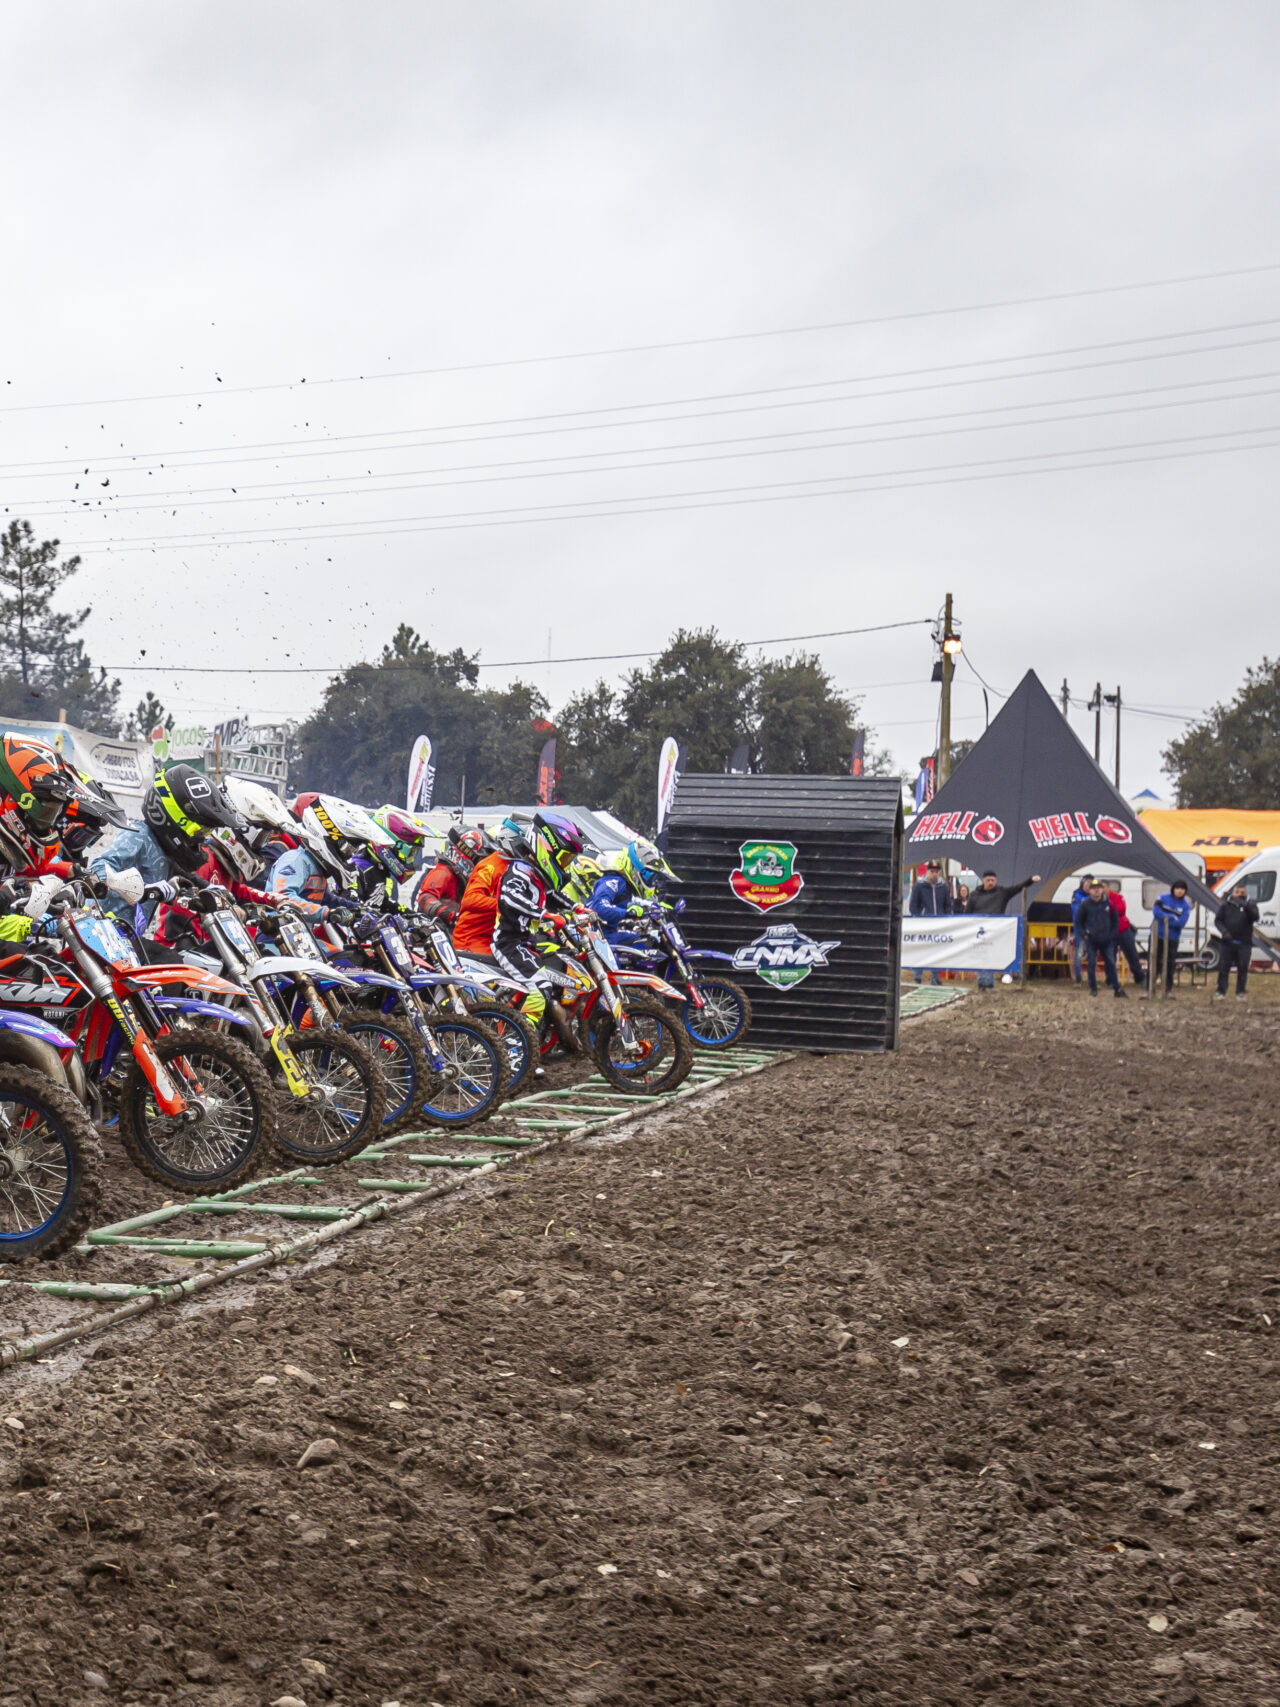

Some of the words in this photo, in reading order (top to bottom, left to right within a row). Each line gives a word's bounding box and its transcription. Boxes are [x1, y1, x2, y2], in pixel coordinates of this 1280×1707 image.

[313, 805, 343, 841] 100%
[913, 811, 975, 838] HELL
[1028, 811, 1096, 842] HELL
[541, 825, 559, 850] SPRINT
[1192, 836, 1259, 848] KTM
[903, 934, 919, 942] DE
[921, 934, 954, 943] MAGOS
